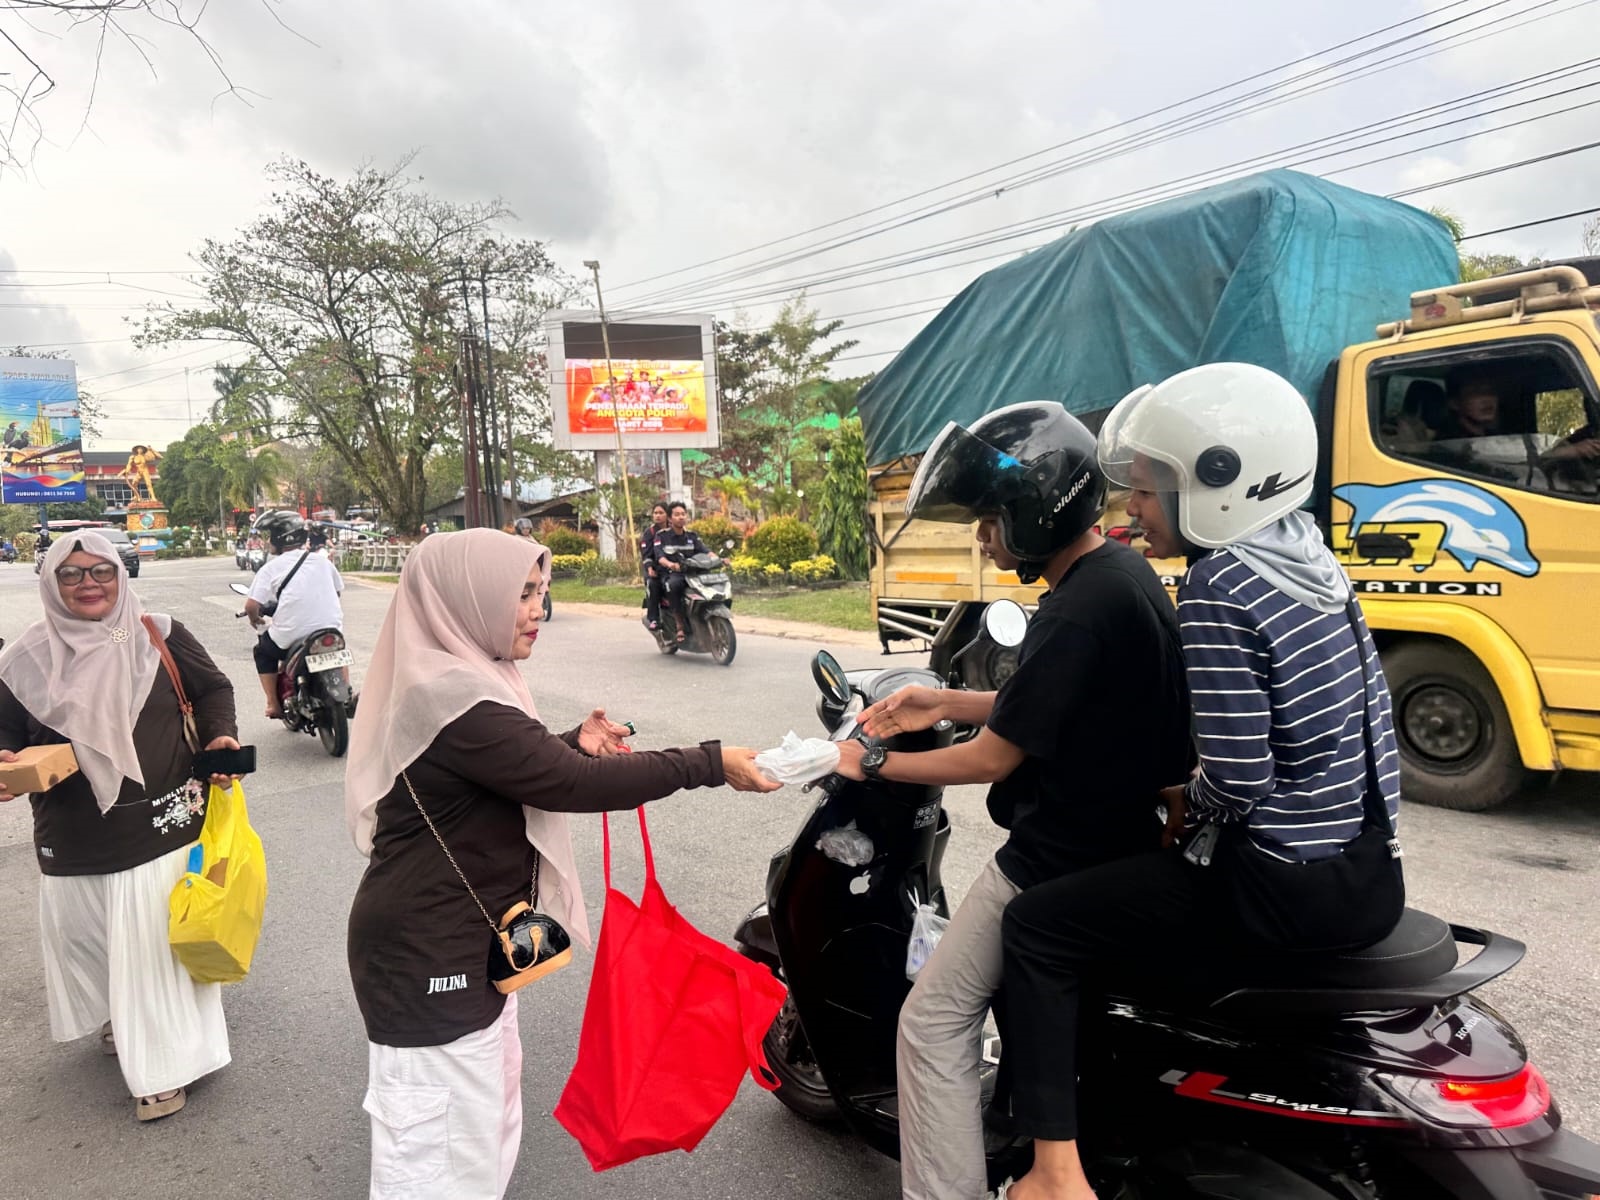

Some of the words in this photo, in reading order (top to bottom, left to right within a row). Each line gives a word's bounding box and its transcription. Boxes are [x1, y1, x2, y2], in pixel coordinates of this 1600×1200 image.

[1053, 471, 1090, 513] olution
[1351, 580, 1499, 596] ATION
[427, 973, 468, 995] JULINA
[1455, 1016, 1481, 1040] HONDA
[1248, 1093, 1349, 1115] Style
